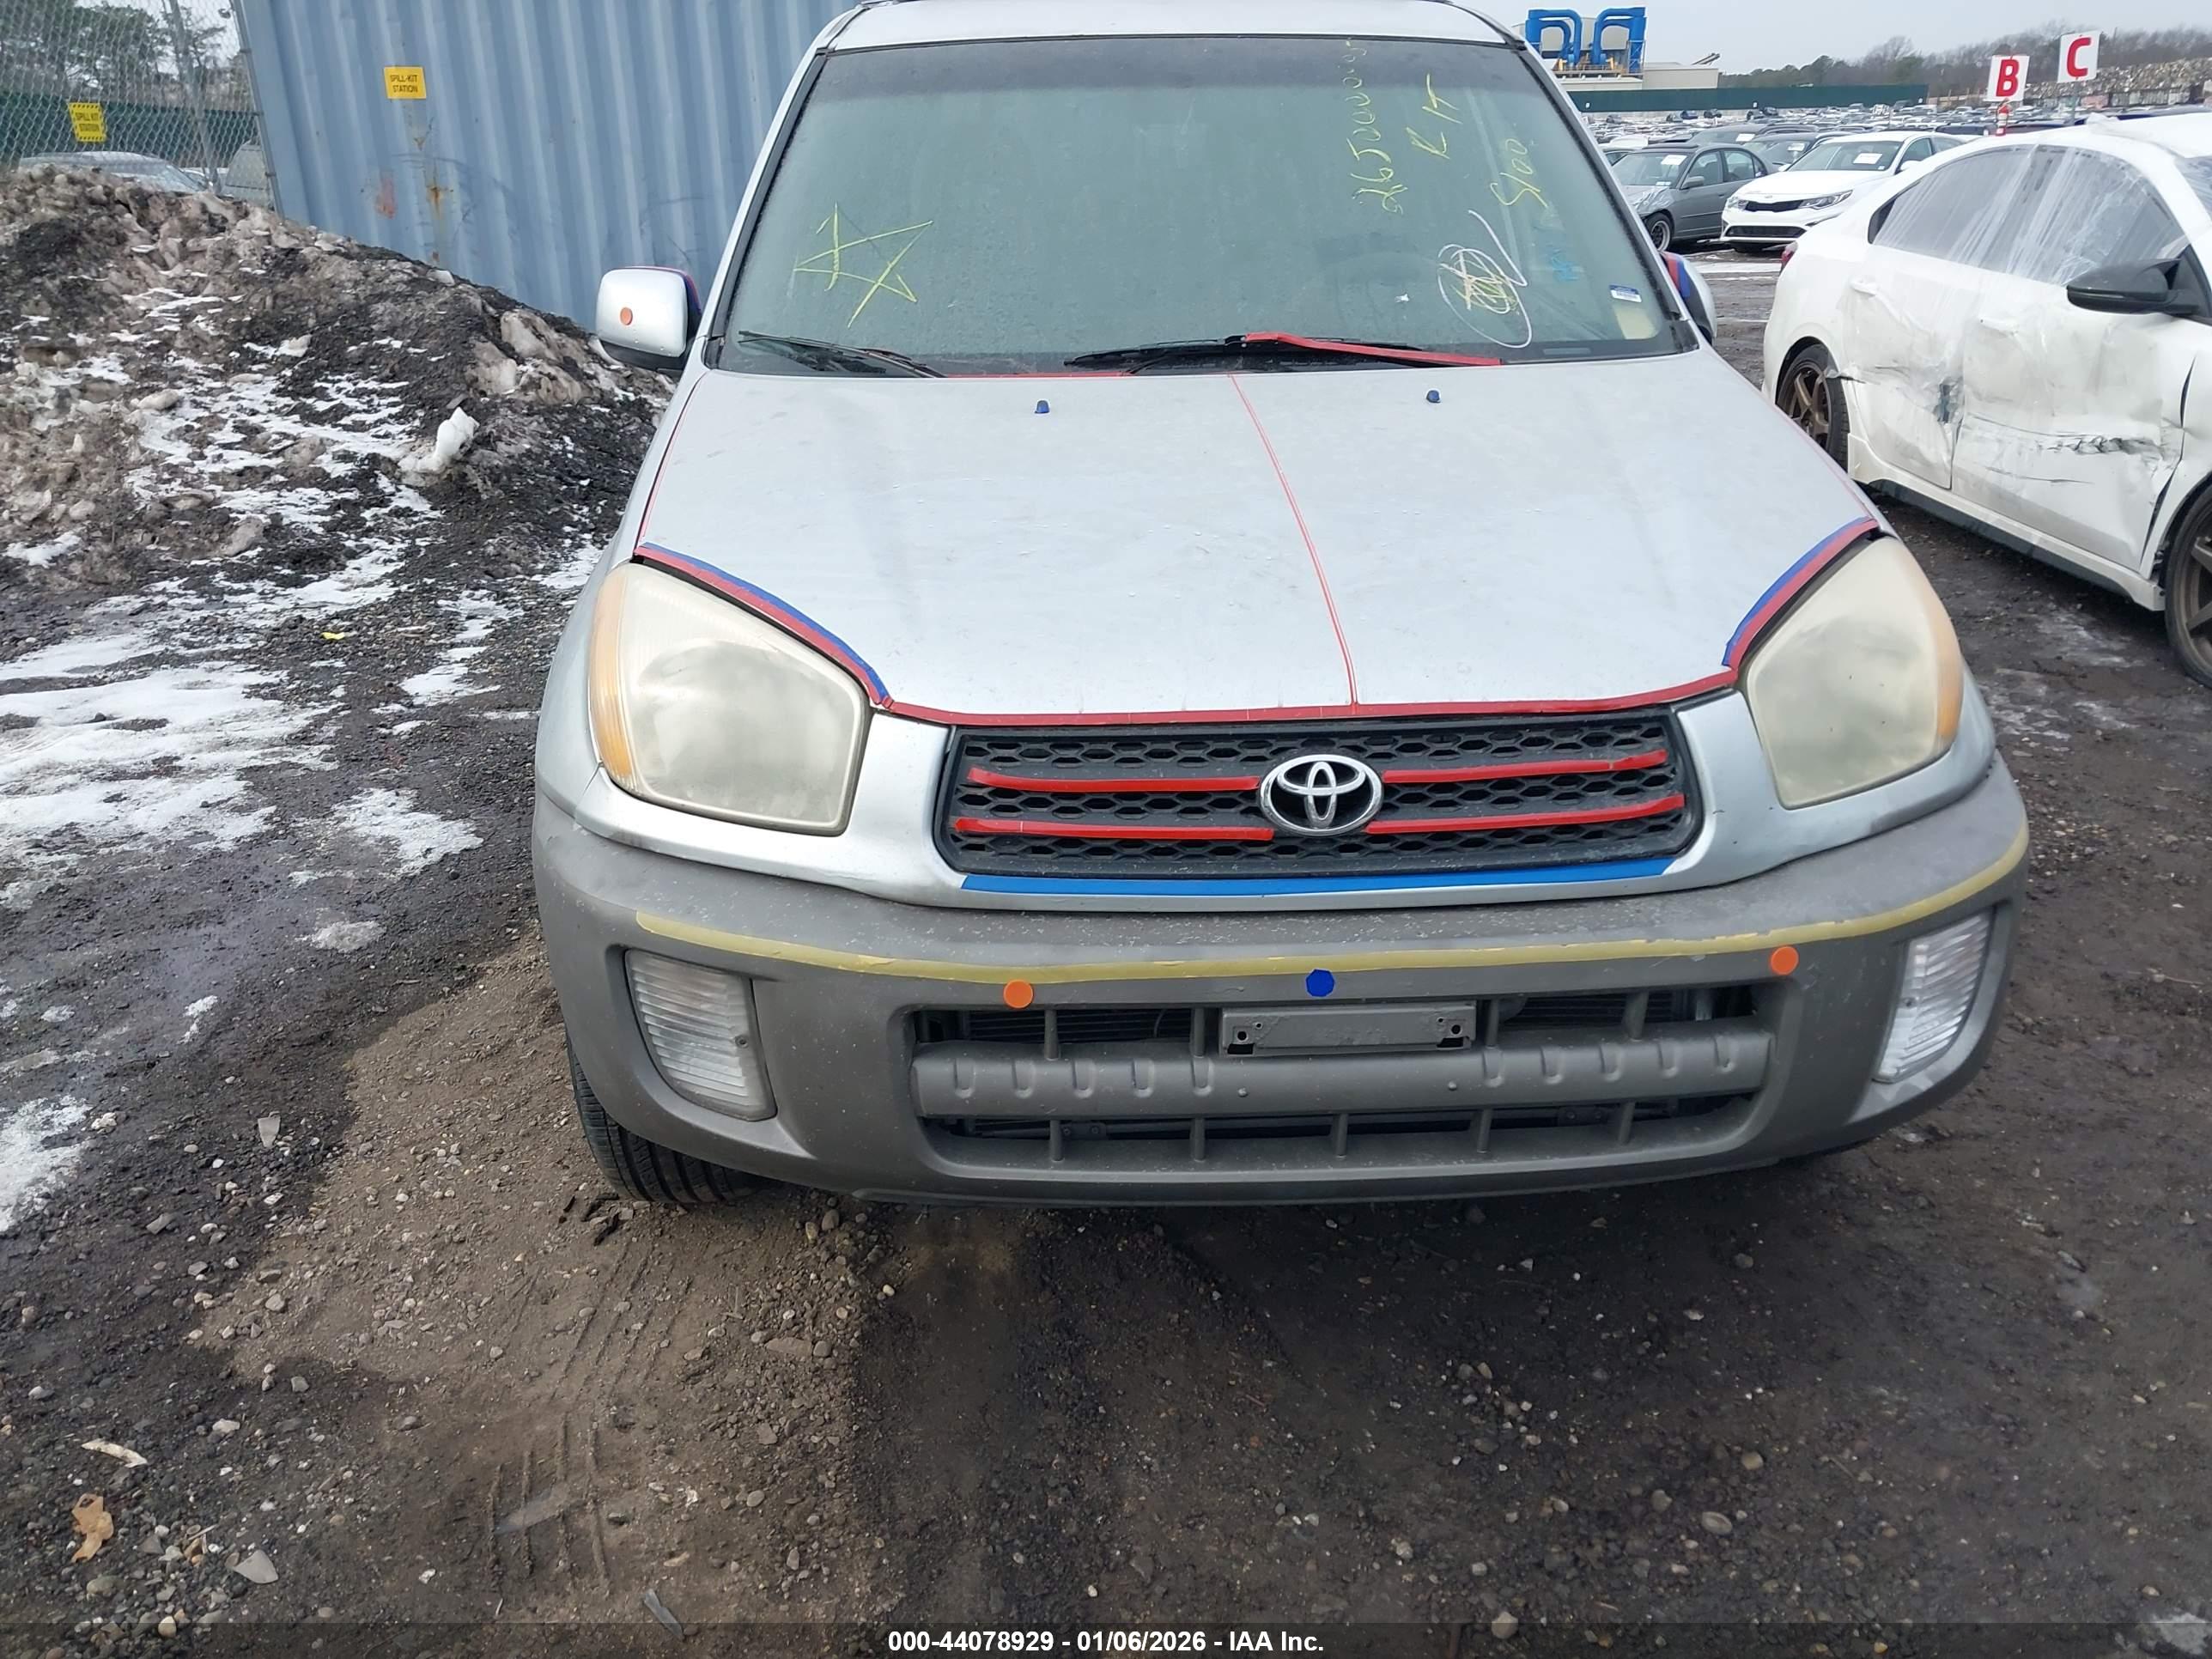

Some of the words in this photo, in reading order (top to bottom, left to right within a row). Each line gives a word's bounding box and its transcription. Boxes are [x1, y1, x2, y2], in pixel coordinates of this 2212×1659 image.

[2067, 37, 2092, 77] C
[392, 84, 418, 93] STATION
[1996, 58, 2020, 97] B
